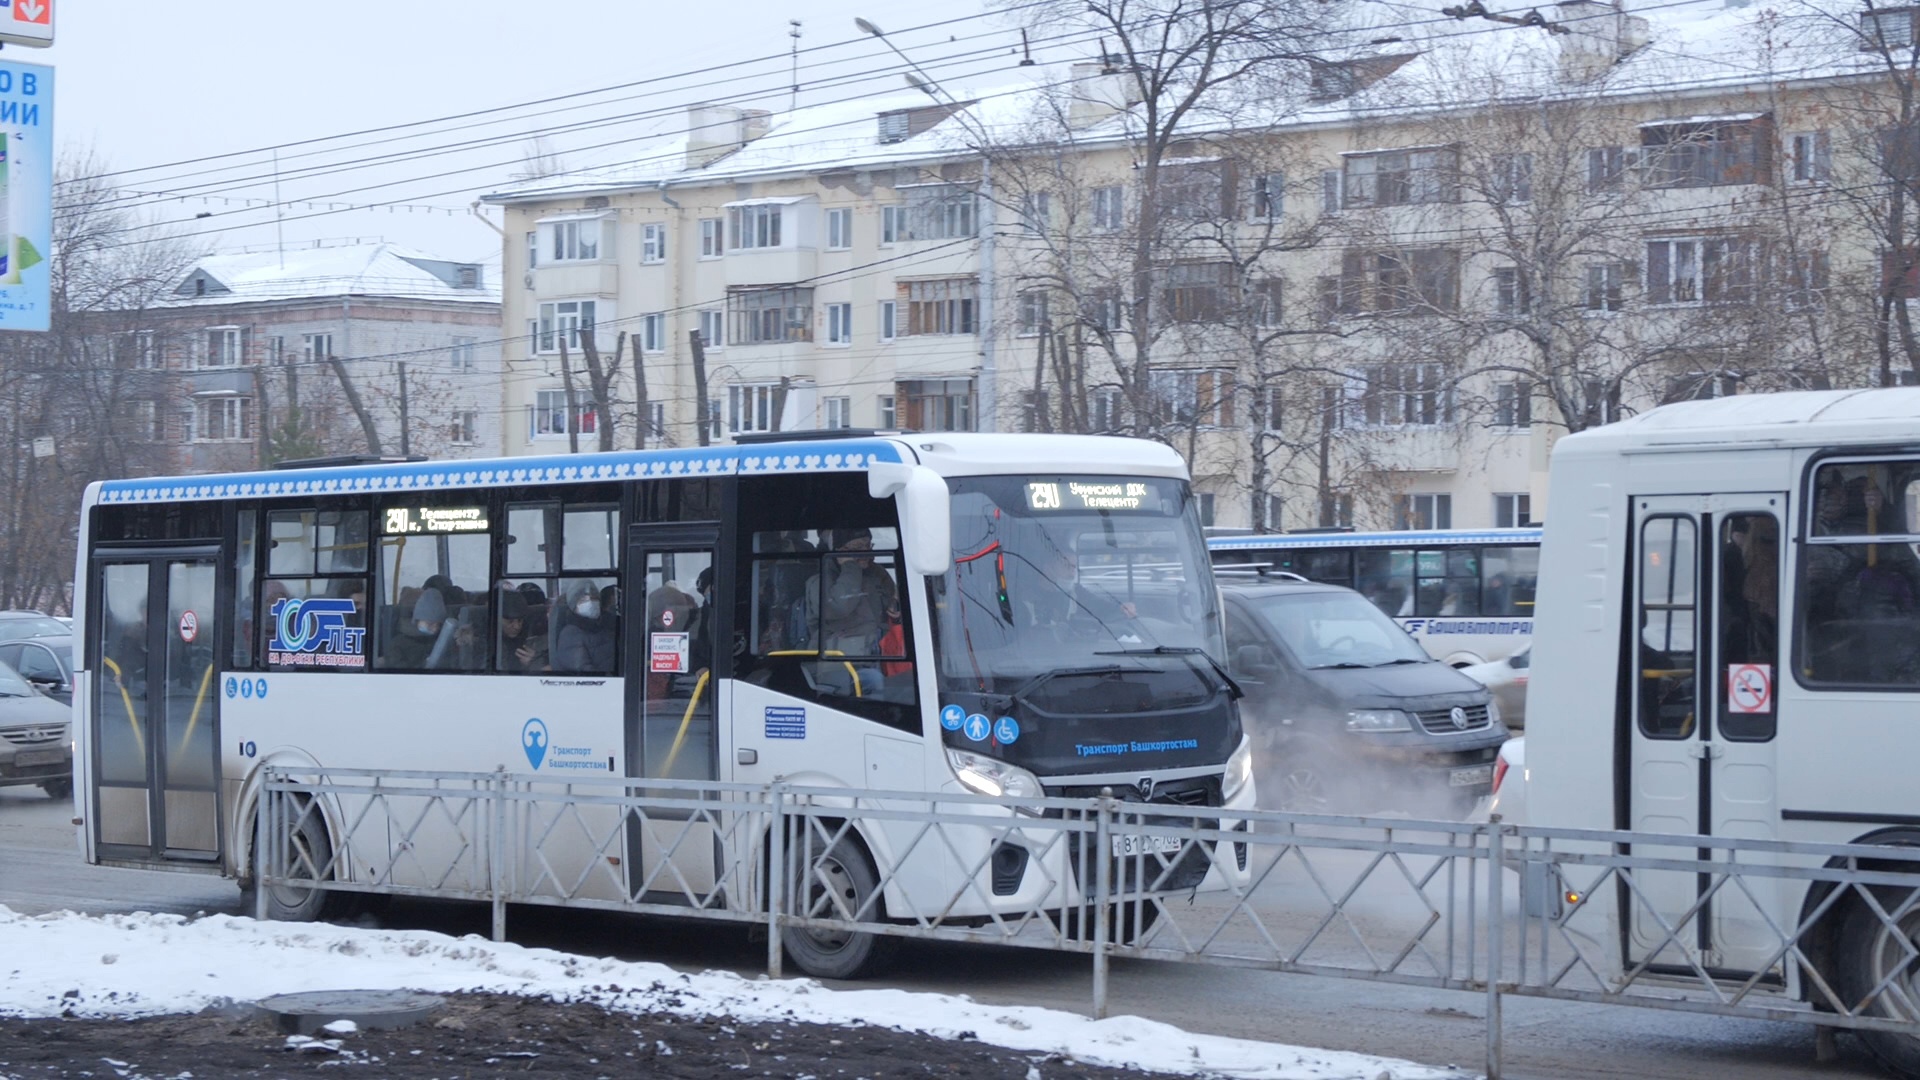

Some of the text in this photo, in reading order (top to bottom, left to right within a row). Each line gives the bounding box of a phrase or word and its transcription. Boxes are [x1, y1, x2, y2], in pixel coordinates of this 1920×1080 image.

[1081, 494, 1139, 508] Телецентр
[386, 508, 409, 533] 290
[419, 507, 480, 520] Телецентр
[326, 627, 366, 653] ЛЕТ
[268, 653, 365, 667] НА ДОРОГАХ РЕСПУБЛИКИ
[552, 745, 592, 757] Транспорт
[1075, 738, 1198, 757] Транспорт Башкортостана
[548, 758, 607, 770] Башкортостана
